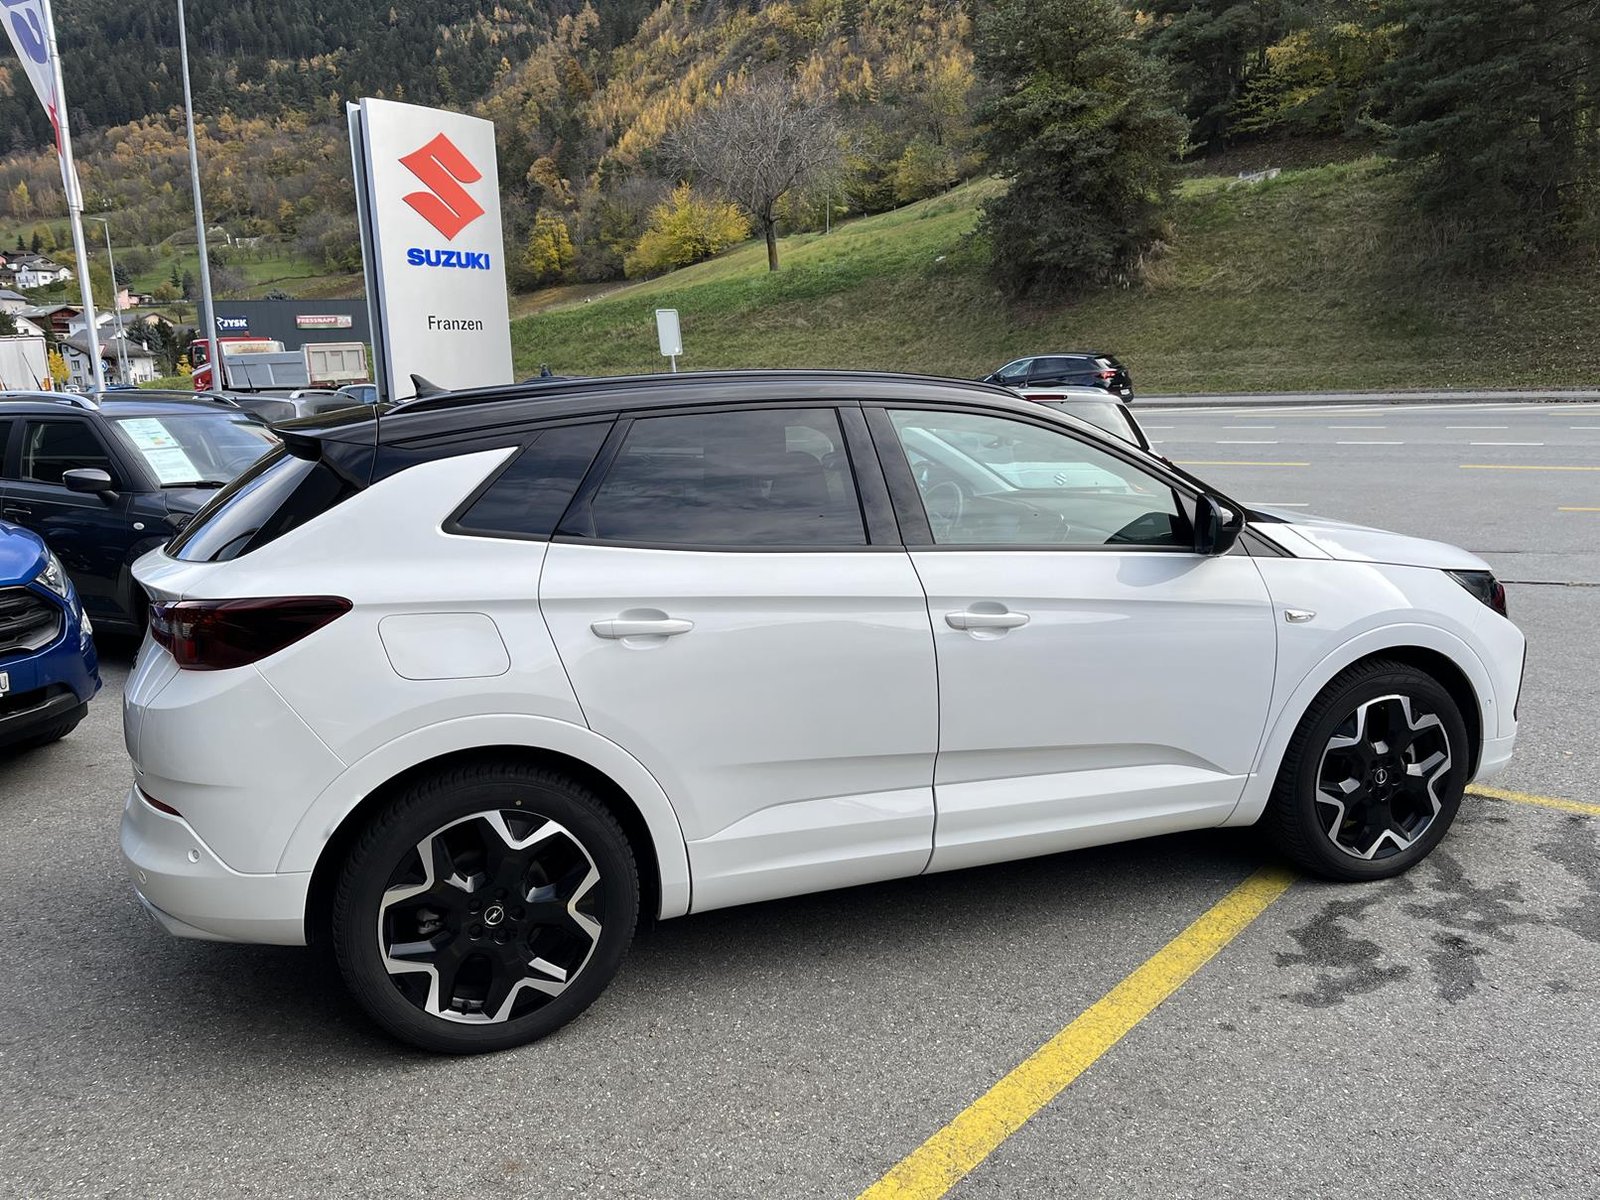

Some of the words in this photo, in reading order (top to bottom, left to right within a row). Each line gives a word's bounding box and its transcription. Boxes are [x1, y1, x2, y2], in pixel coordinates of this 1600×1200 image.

[407, 248, 491, 270] SUZUKI
[222, 319, 248, 328] JYSK
[428, 315, 483, 331] Franzen
